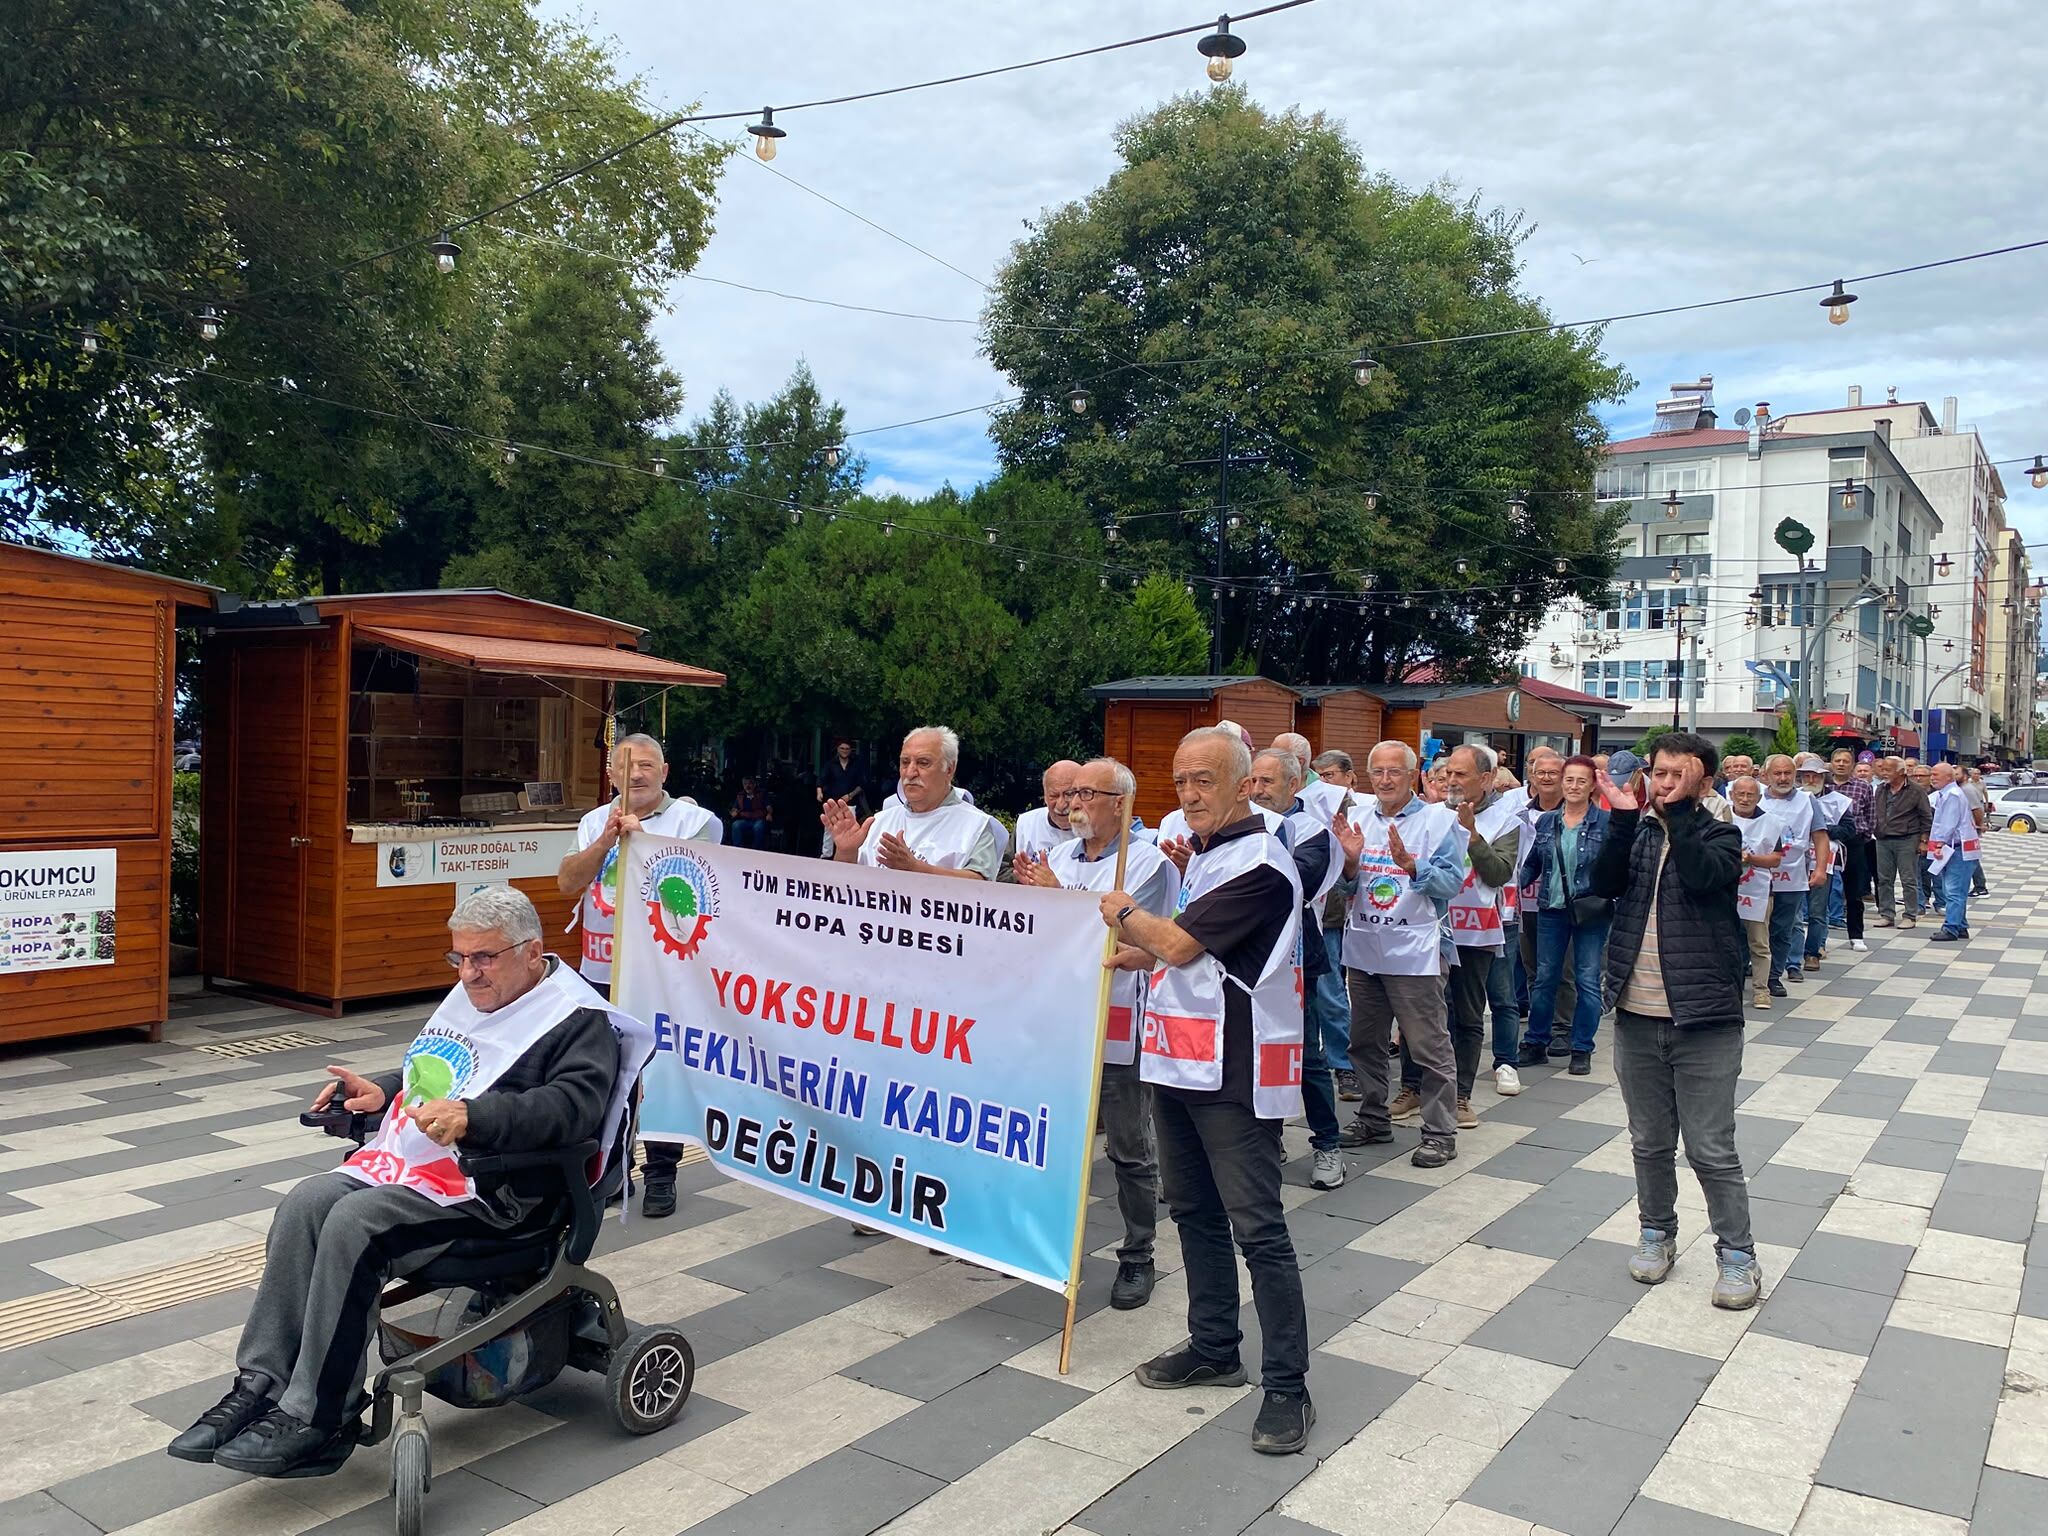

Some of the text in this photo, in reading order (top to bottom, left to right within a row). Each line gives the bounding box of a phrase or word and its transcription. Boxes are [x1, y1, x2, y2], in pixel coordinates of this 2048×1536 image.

[441, 840, 538, 856] ÖZNUR DOĞAL TAŞ
[441, 856, 509, 873] TAKI-TESBİH
[0, 866, 95, 888] OKUMCU
[5, 886, 96, 900] ÜRÜNLER PAZARI
[742, 870, 1034, 935] TÜM EMEKLİLERİN SENDİKASI
[12, 916, 52, 928] HOPA
[1360, 913, 1408, 925] HOPA
[776, 909, 963, 957] HOPA ŞUBESİ
[12, 942, 52, 954] HOPA
[711, 967, 976, 1064] YOKSULLUK
[883, 1081, 1048, 1167] KADERİ
[706, 1107, 947, 1229] DEĞİLDİR
